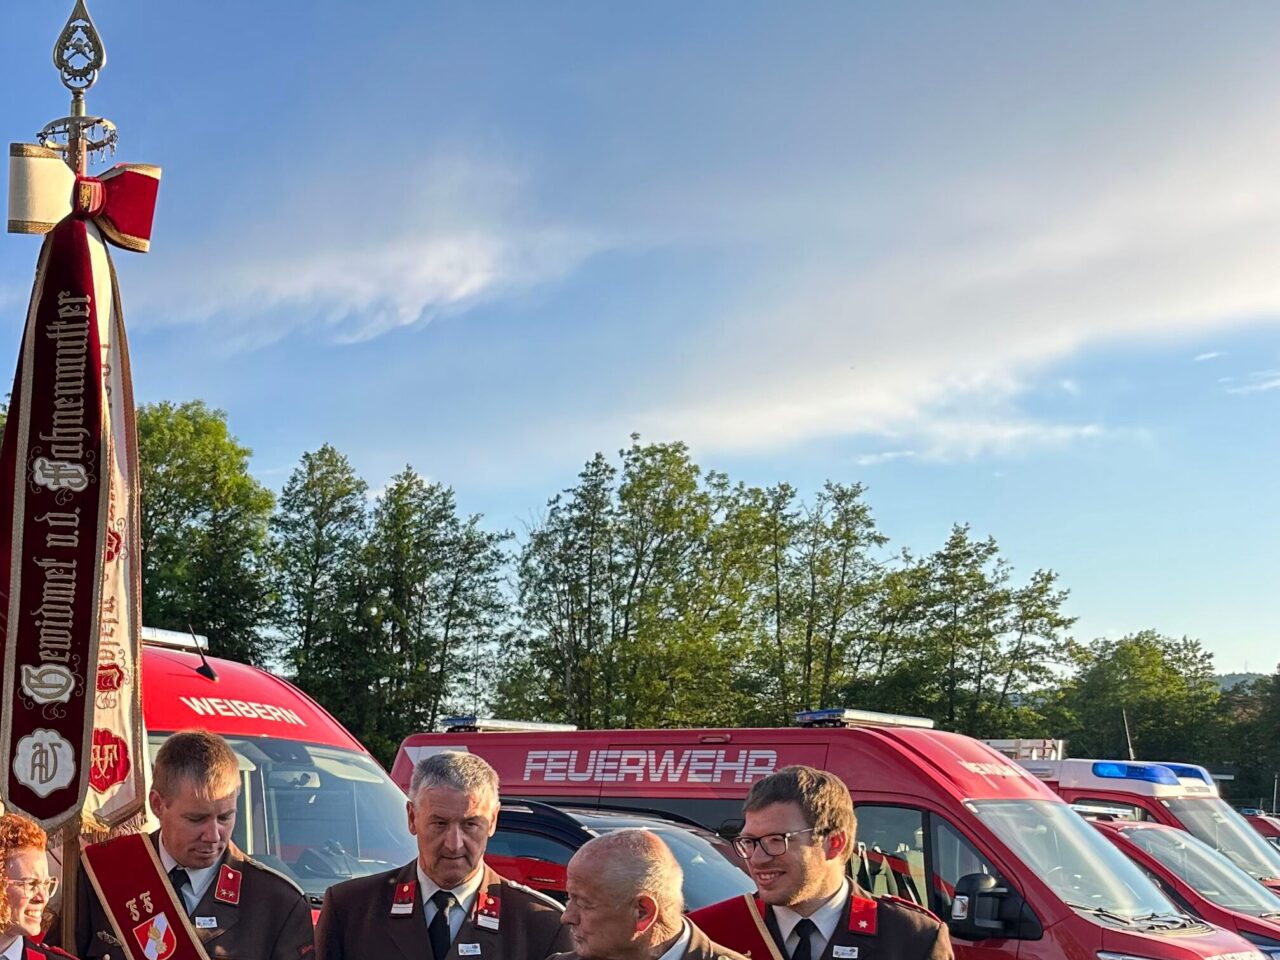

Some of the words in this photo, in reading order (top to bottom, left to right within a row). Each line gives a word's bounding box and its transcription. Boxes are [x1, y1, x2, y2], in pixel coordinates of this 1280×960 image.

[38, 290, 91, 488] Fahnenmutter
[179, 696, 307, 727] WEIBERN
[523, 750, 777, 783] FEUERWEHR
